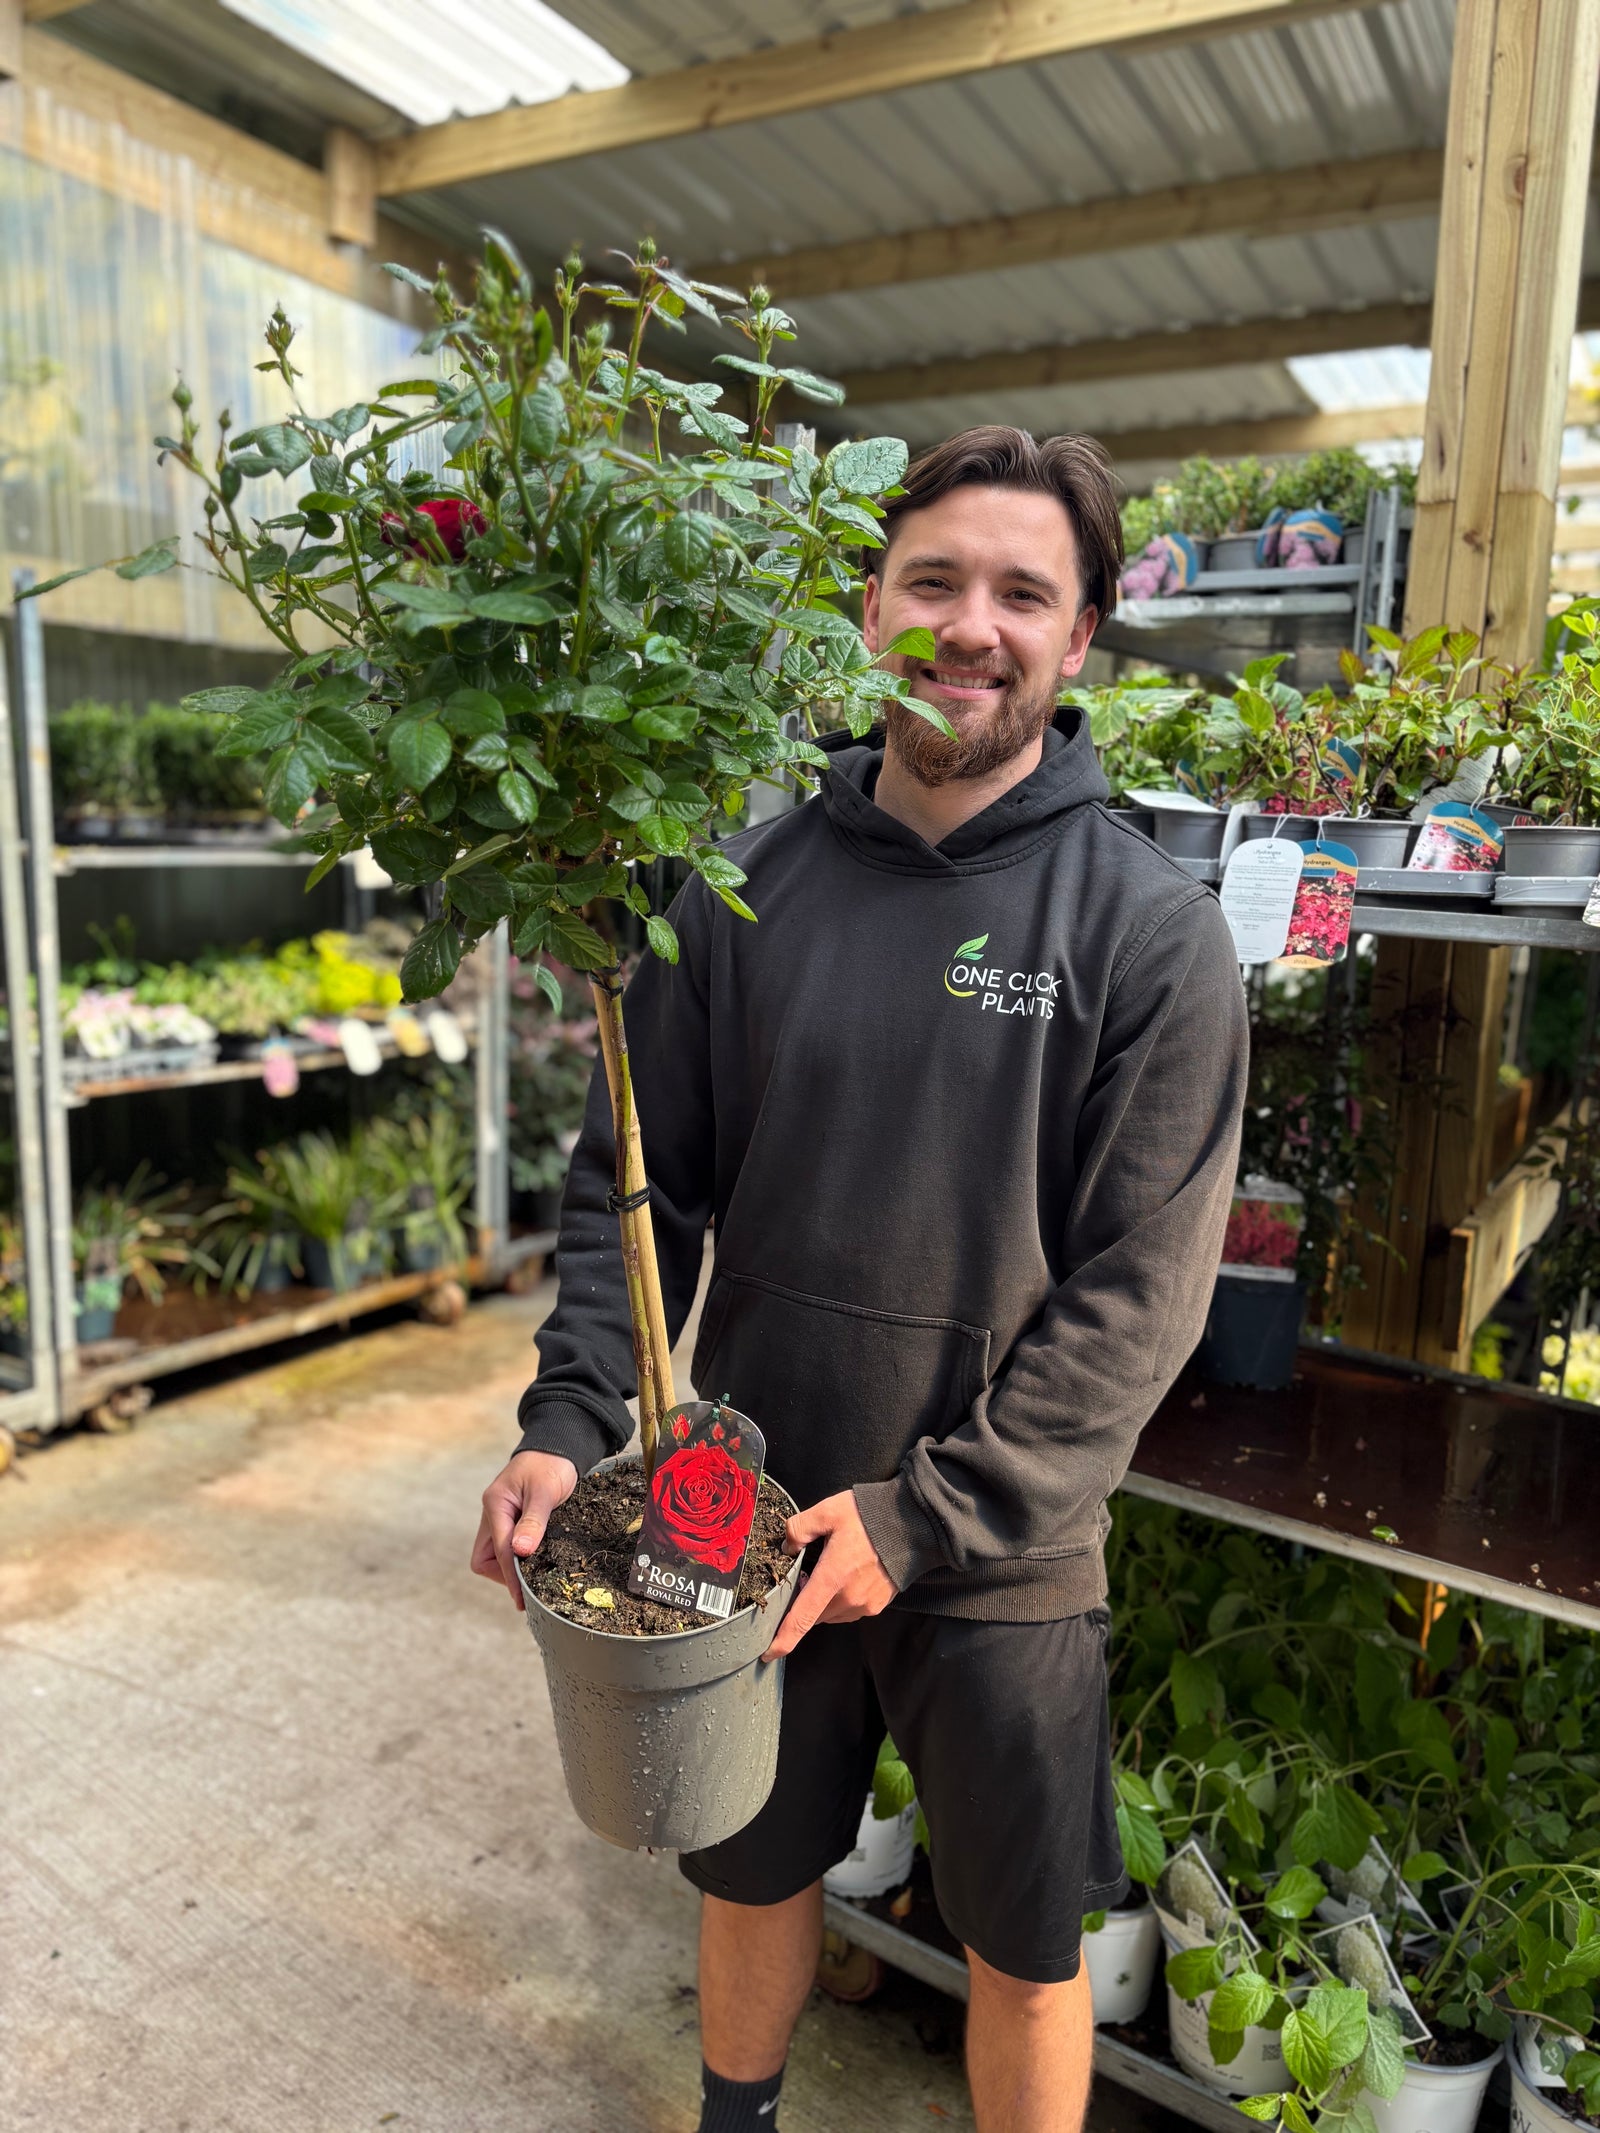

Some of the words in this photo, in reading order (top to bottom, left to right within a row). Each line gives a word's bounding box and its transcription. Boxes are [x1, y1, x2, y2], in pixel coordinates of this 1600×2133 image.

[1453, 820, 1480, 835] Hydrangea
[952, 964, 1004, 988] ONE
[981, 992, 1056, 1020] PLANTS
[648, 1564, 697, 1596] ROSA
[646, 1586, 673, 1601] ROYAL
[674, 1594, 692, 1607] RED
